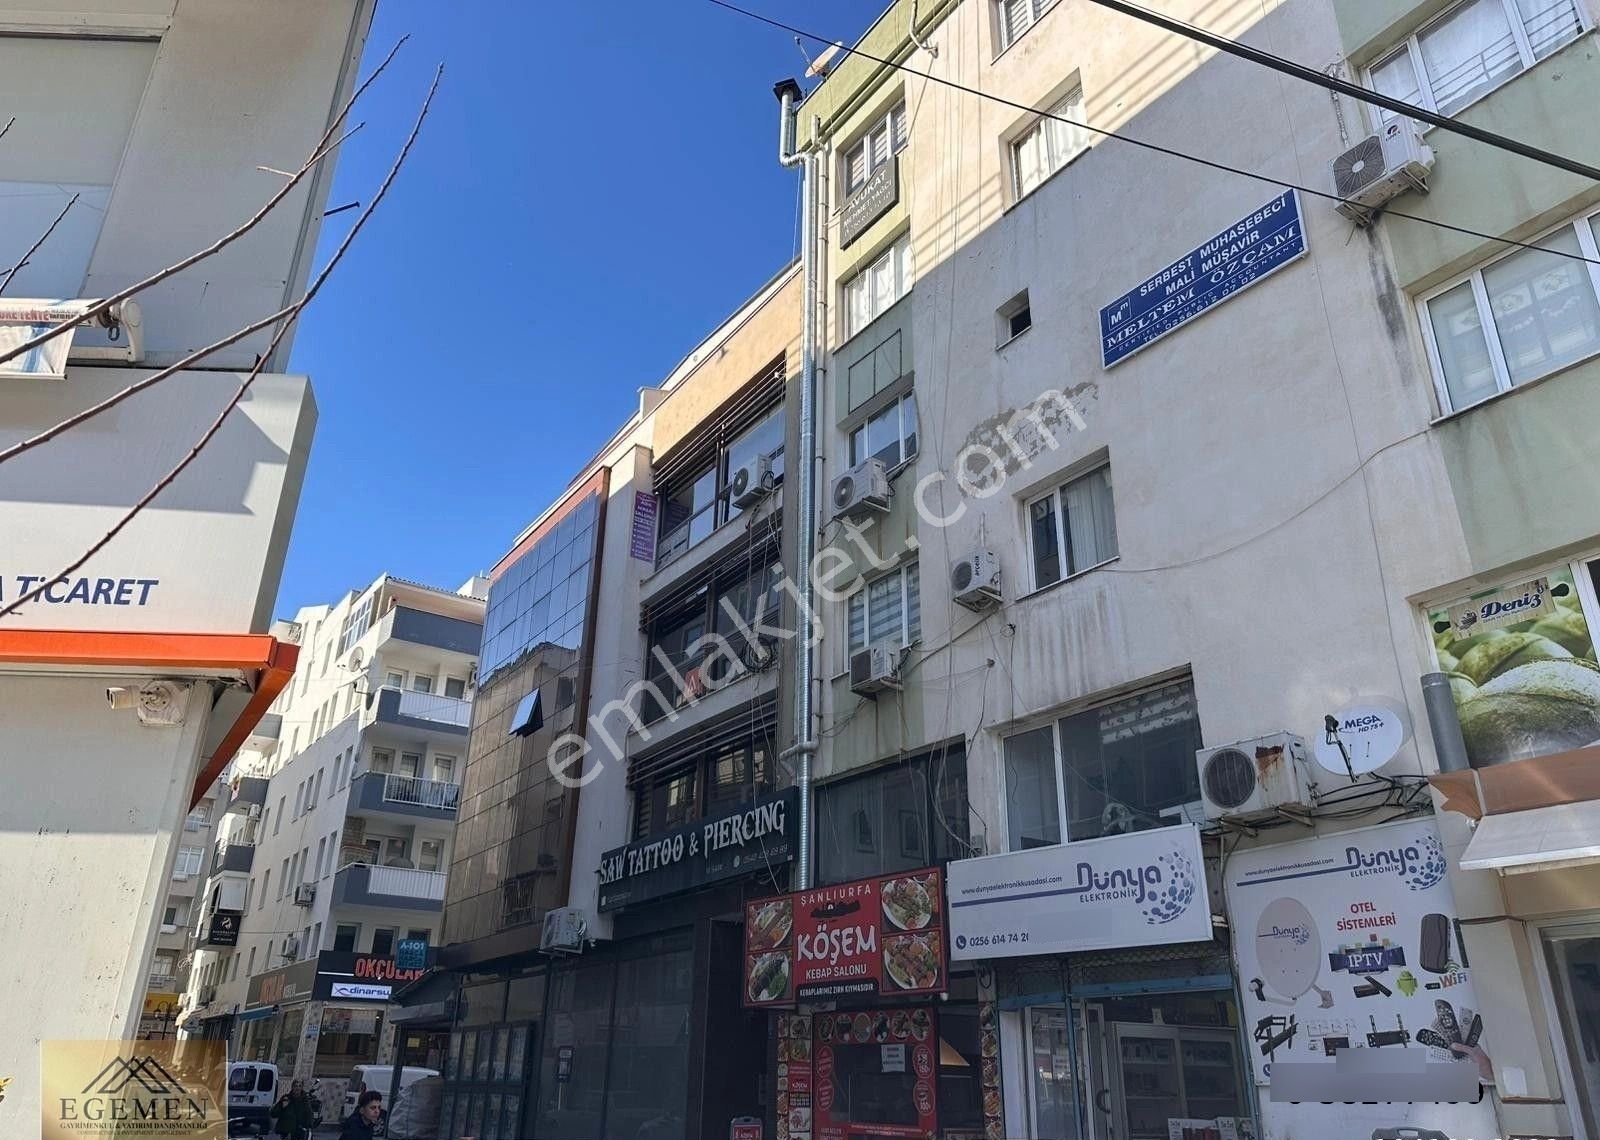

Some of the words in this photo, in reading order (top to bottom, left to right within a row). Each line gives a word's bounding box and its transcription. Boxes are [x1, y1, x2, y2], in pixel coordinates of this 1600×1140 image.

[1140, 256, 1193, 297] SERBEST
[1200, 195, 1287, 259] MUHASEBECİ
[1165, 267, 1195, 296] MALİ
[1201, 230, 1260, 273] MÜŞAVİR
[1107, 288, 1196, 348] MELTEM
[1210, 225, 1297, 283] ÖZÇAM
[1481, 592, 1542, 619] Deniz
[1344, 714, 1381, 730] MEGA
[1358, 725, 1369, 733] HD
[600, 846, 628, 885] SAW
[628, 833, 684, 877] TATTOO
[688, 831, 699, 857] &
[703, 799, 785, 860] PIERCING
[1345, 846, 1419, 876] Dünya
[1350, 864, 1400, 878] ELEKTRONİK
[1076, 862, 1162, 904] Dünya
[800, 883, 872, 908] ŞANLIURFA
[1080, 888, 1138, 903] ELEKTRONİK
[1350, 902, 1377, 914] OTEL
[1336, 912, 1397, 931] SİSTEMLERİ
[797, 923, 877, 966] KÖŞEM
[969, 936, 989, 947] 0256
[992, 934, 1005, 945] 614
[1008, 933, 1019, 944] 74
[1348, 952, 1384, 968] IPTV
[805, 966, 832, 980] KEBAP
[834, 963, 867, 977] SALONU
[1439, 972, 1468, 989] WiFi
[350, 986, 390, 996] dinarsu
